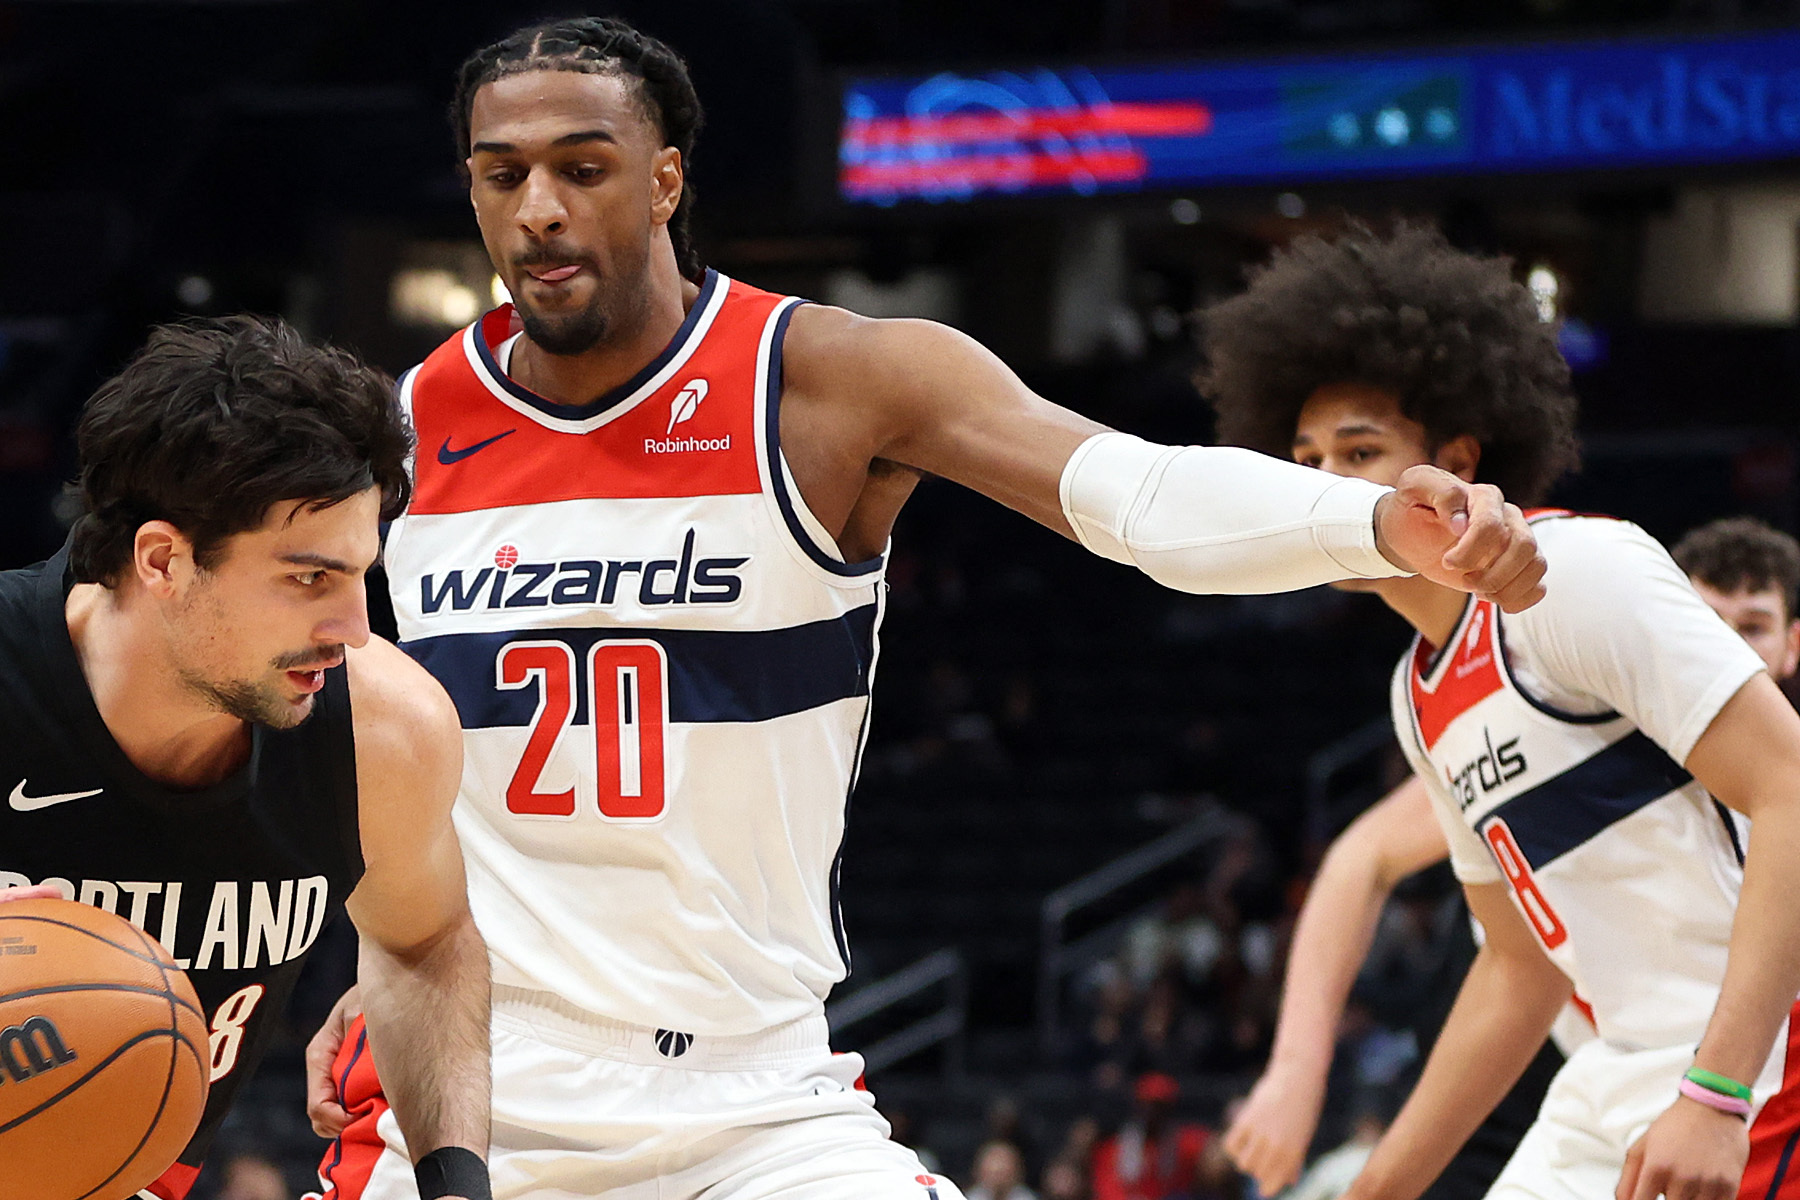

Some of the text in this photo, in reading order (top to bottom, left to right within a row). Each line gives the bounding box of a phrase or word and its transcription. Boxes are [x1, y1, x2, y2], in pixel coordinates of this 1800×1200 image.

[643, 434, 731, 454] Robinhood
[419, 527, 752, 615] wizards
[496, 639, 671, 824] 20
[1484, 817, 1570, 954] 8
[209, 982, 266, 1084] 8
